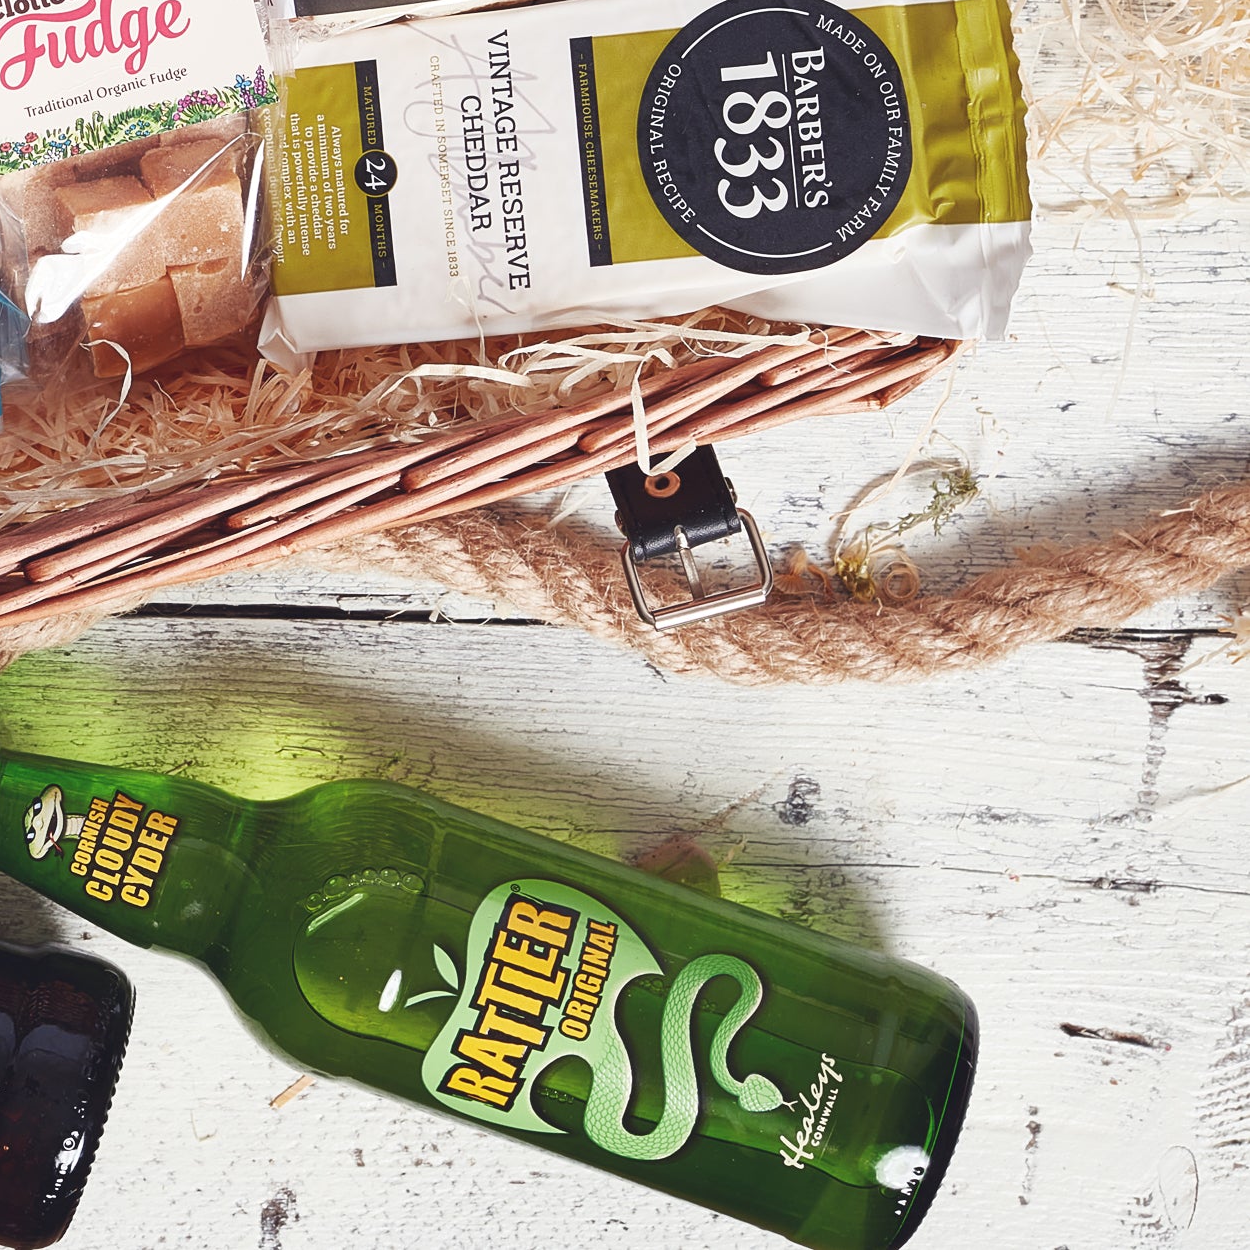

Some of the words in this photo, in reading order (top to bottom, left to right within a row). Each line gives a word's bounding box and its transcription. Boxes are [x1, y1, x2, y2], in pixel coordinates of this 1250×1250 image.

[815, 14, 866, 55] MADE
[864, 52, 886, 79] ON
[23, 89, 95, 119] Traditional
[97, 77, 148, 102] Organic
[150, 65, 188, 89] Fudge
[364, 85, 377, 145] MATURED
[430, 55, 445, 116] CRAFTED
[487, 29, 518, 154] VINTAGE
[578, 63, 593, 140] FARMHOUSE
[649, 63, 682, 154] ORIGINAL
[879, 81, 901, 122] OUR
[331, 125, 343, 167] Always
[713, 51, 792, 219] 1833
[791, 45, 832, 208] BARBER'S
[281, 150, 293, 199] complex
[364, 158, 388, 191] 24
[437, 136, 452, 206] SOMERSET
[460, 95, 492, 232] CHEDDAR
[584, 141, 603, 241] CHEESEMAKERS
[653, 158, 696, 223] RECIPE
[878, 126, 903, 198] FAMILY
[291, 150, 307, 212] powerfully
[299, 213, 310, 256] intense
[374, 203, 388, 259] MONTHS
[443, 208, 456, 248] SINCE
[498, 159, 531, 291] RESERVE
[835, 196, 882, 242] FARM
[447, 250, 459, 278] 1833
[70, 797, 110, 876] CORNISH
[85, 793, 144, 901] CLOUDY
[120, 811, 179, 908] CYDER
[560, 920, 616, 1040] ORIGINAL
[810, 1088, 839, 1147] CORNWALL
